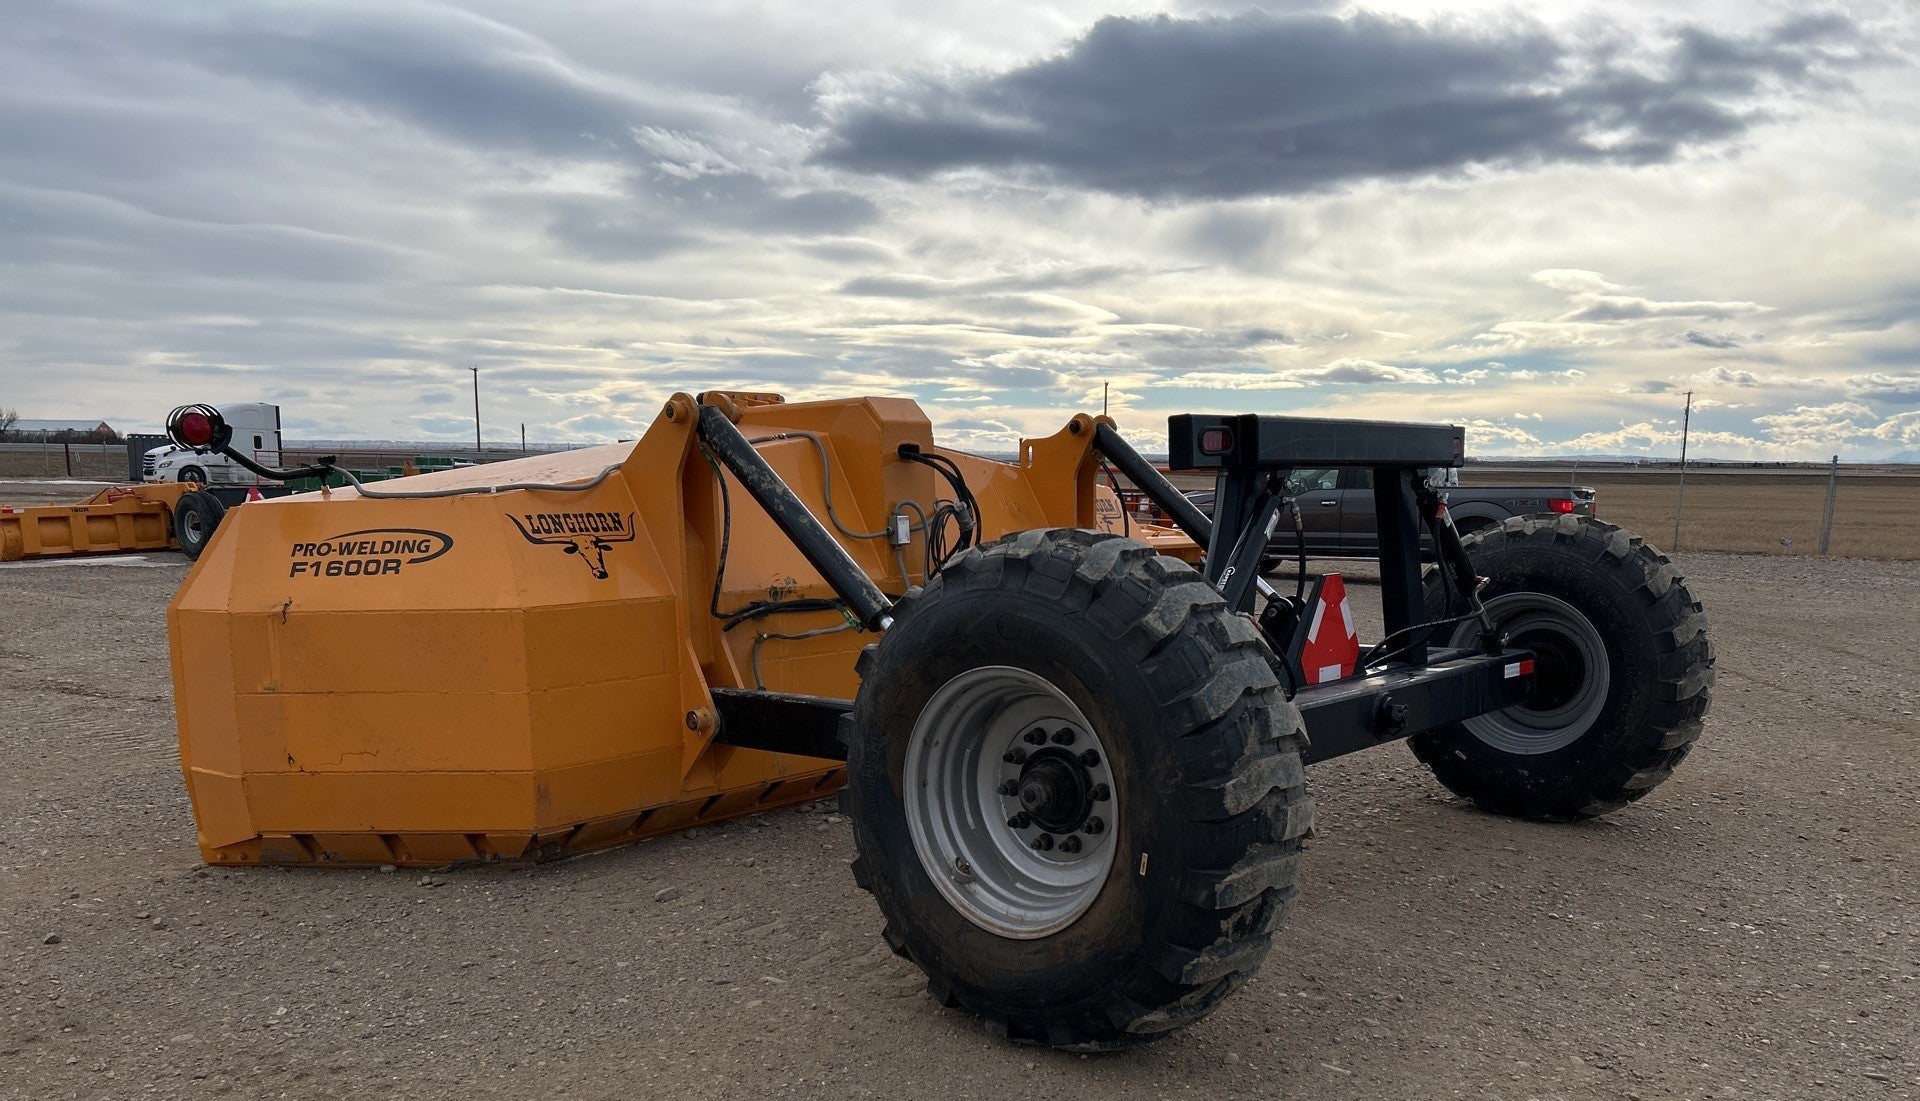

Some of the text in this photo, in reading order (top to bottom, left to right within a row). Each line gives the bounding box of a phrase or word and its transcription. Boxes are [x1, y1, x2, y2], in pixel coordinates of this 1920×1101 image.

[524, 512, 625, 534] LONGHORN
[291, 540, 431, 557] PRO-WELDING
[289, 559, 401, 578] F1600R
